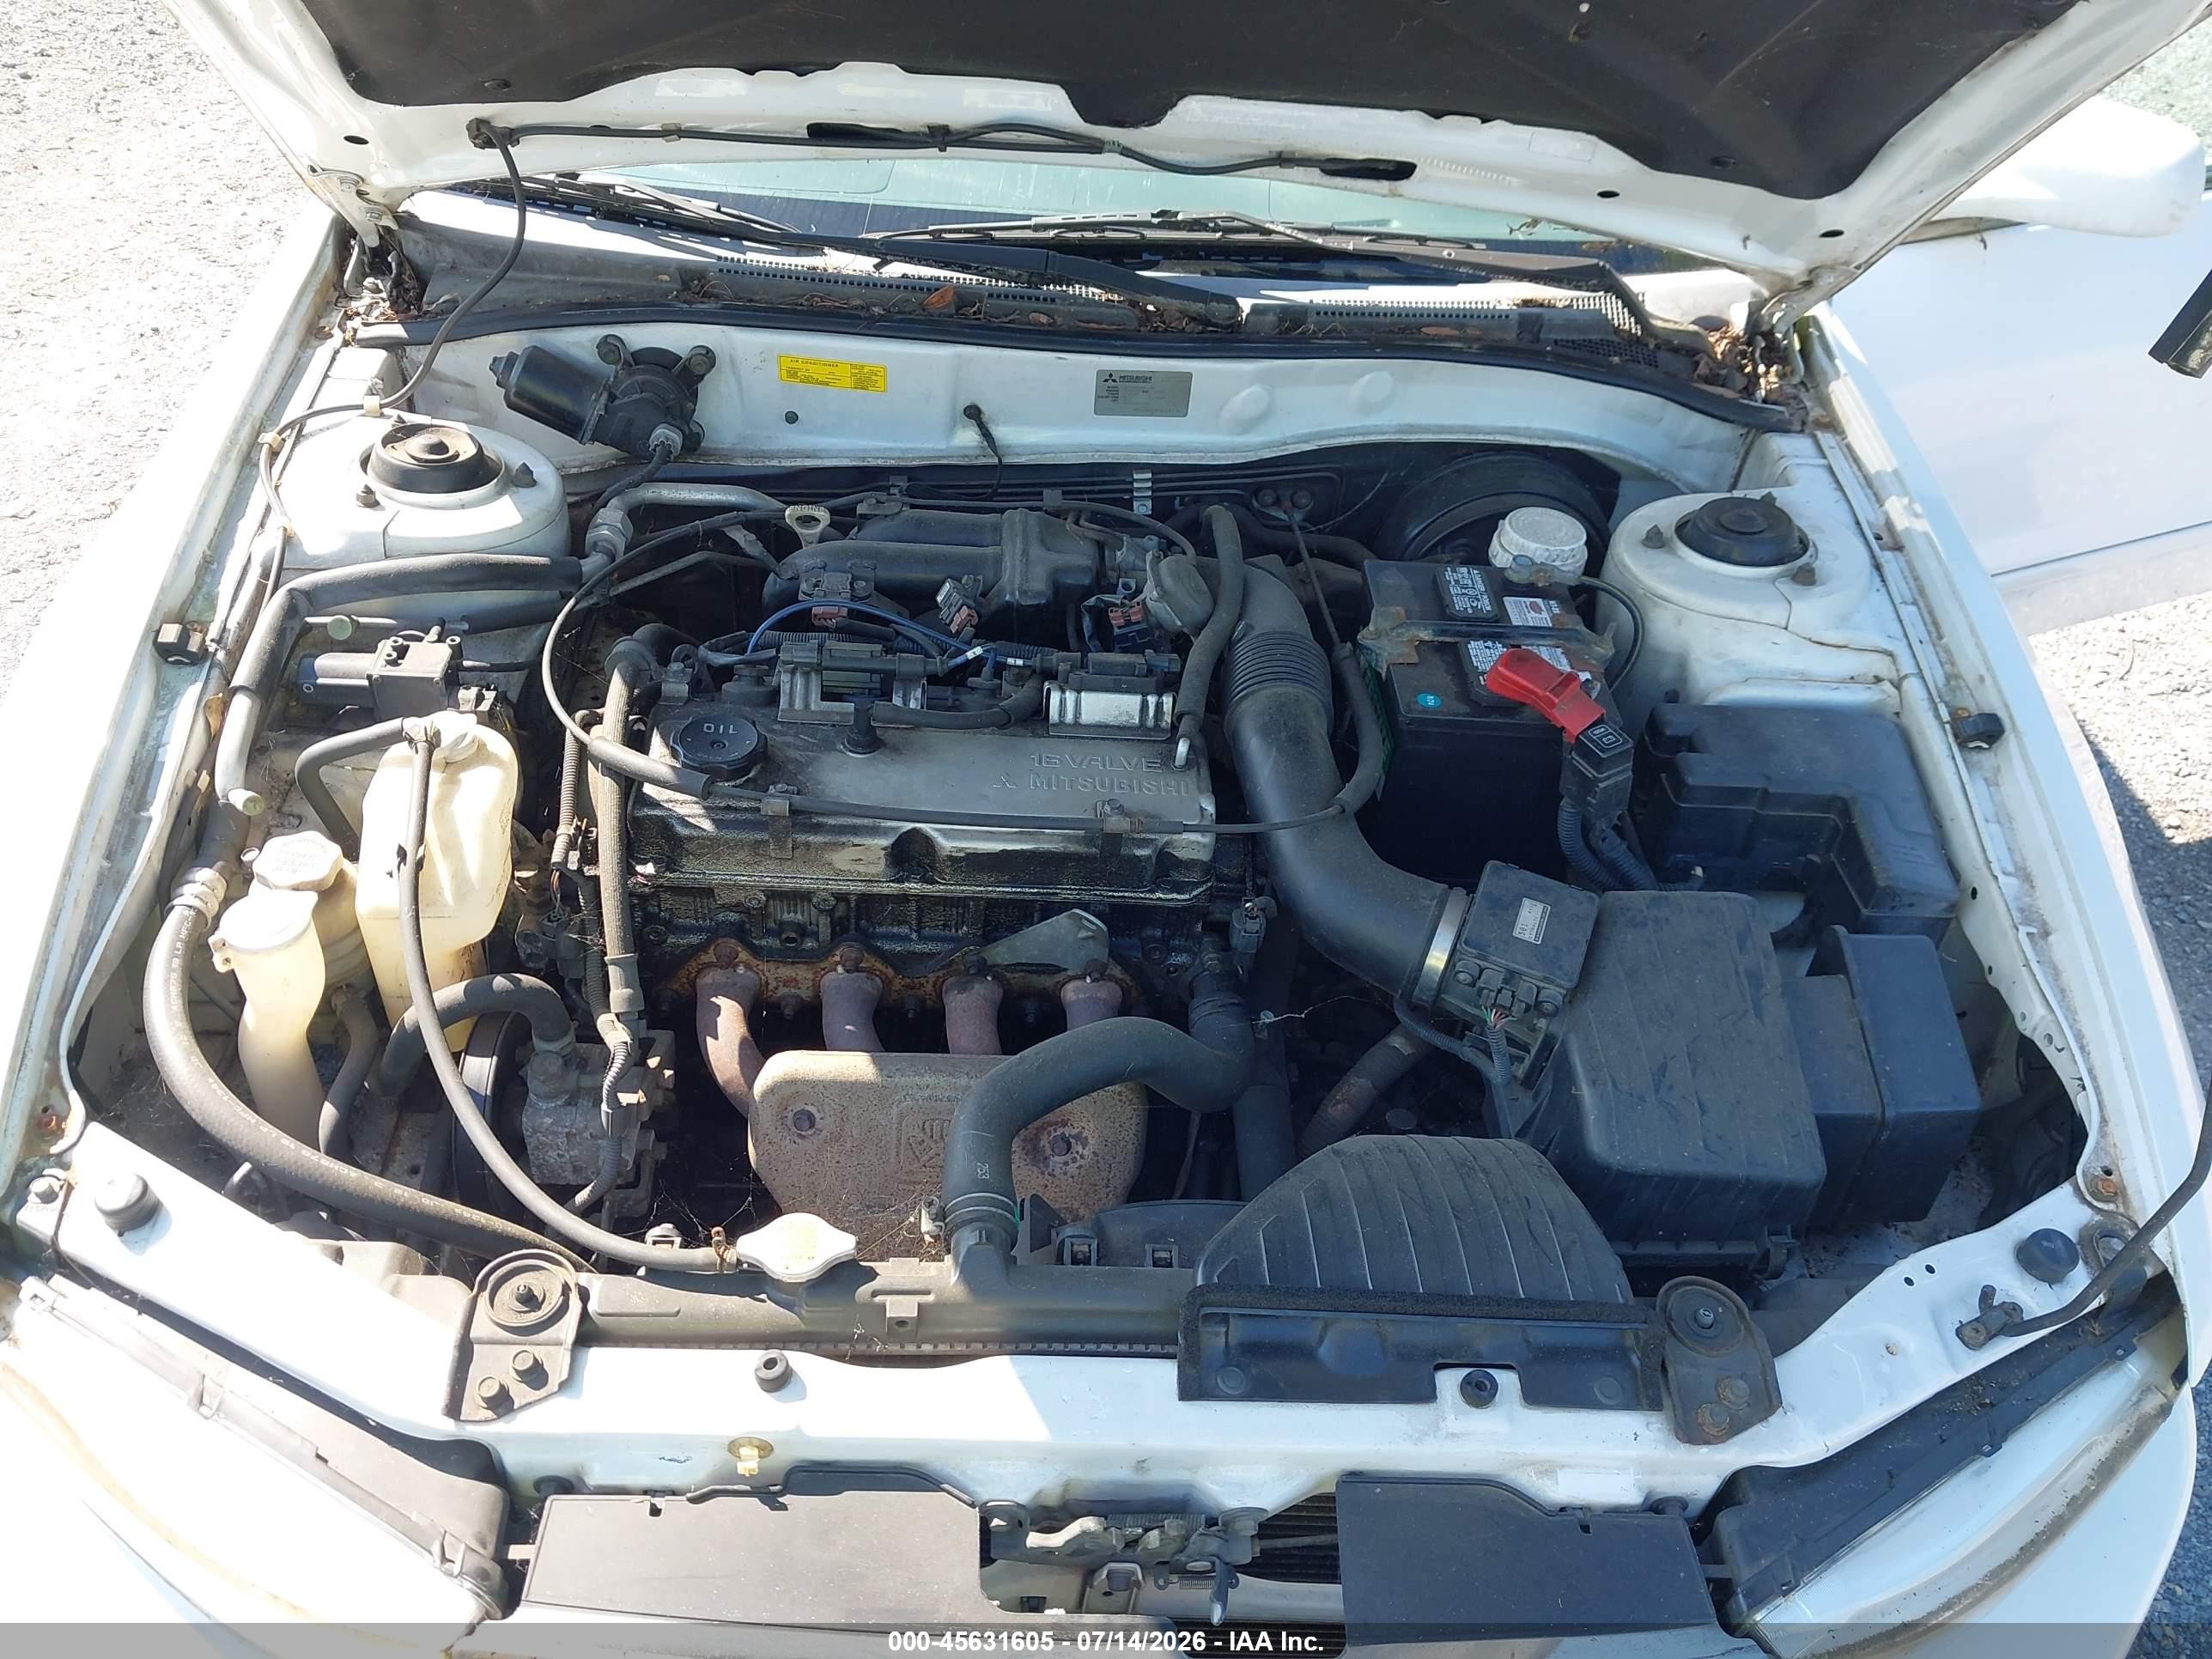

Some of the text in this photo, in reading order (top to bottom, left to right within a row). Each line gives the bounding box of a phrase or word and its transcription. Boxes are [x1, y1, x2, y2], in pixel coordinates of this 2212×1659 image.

[801, 360, 839, 368] CONDITIONER
[702, 722, 738, 734] OIL
[1029, 773, 1190, 797] MITSUBISHI
[174, 940, 185, 955] LP
[976, 1162, 990, 1180] 253
